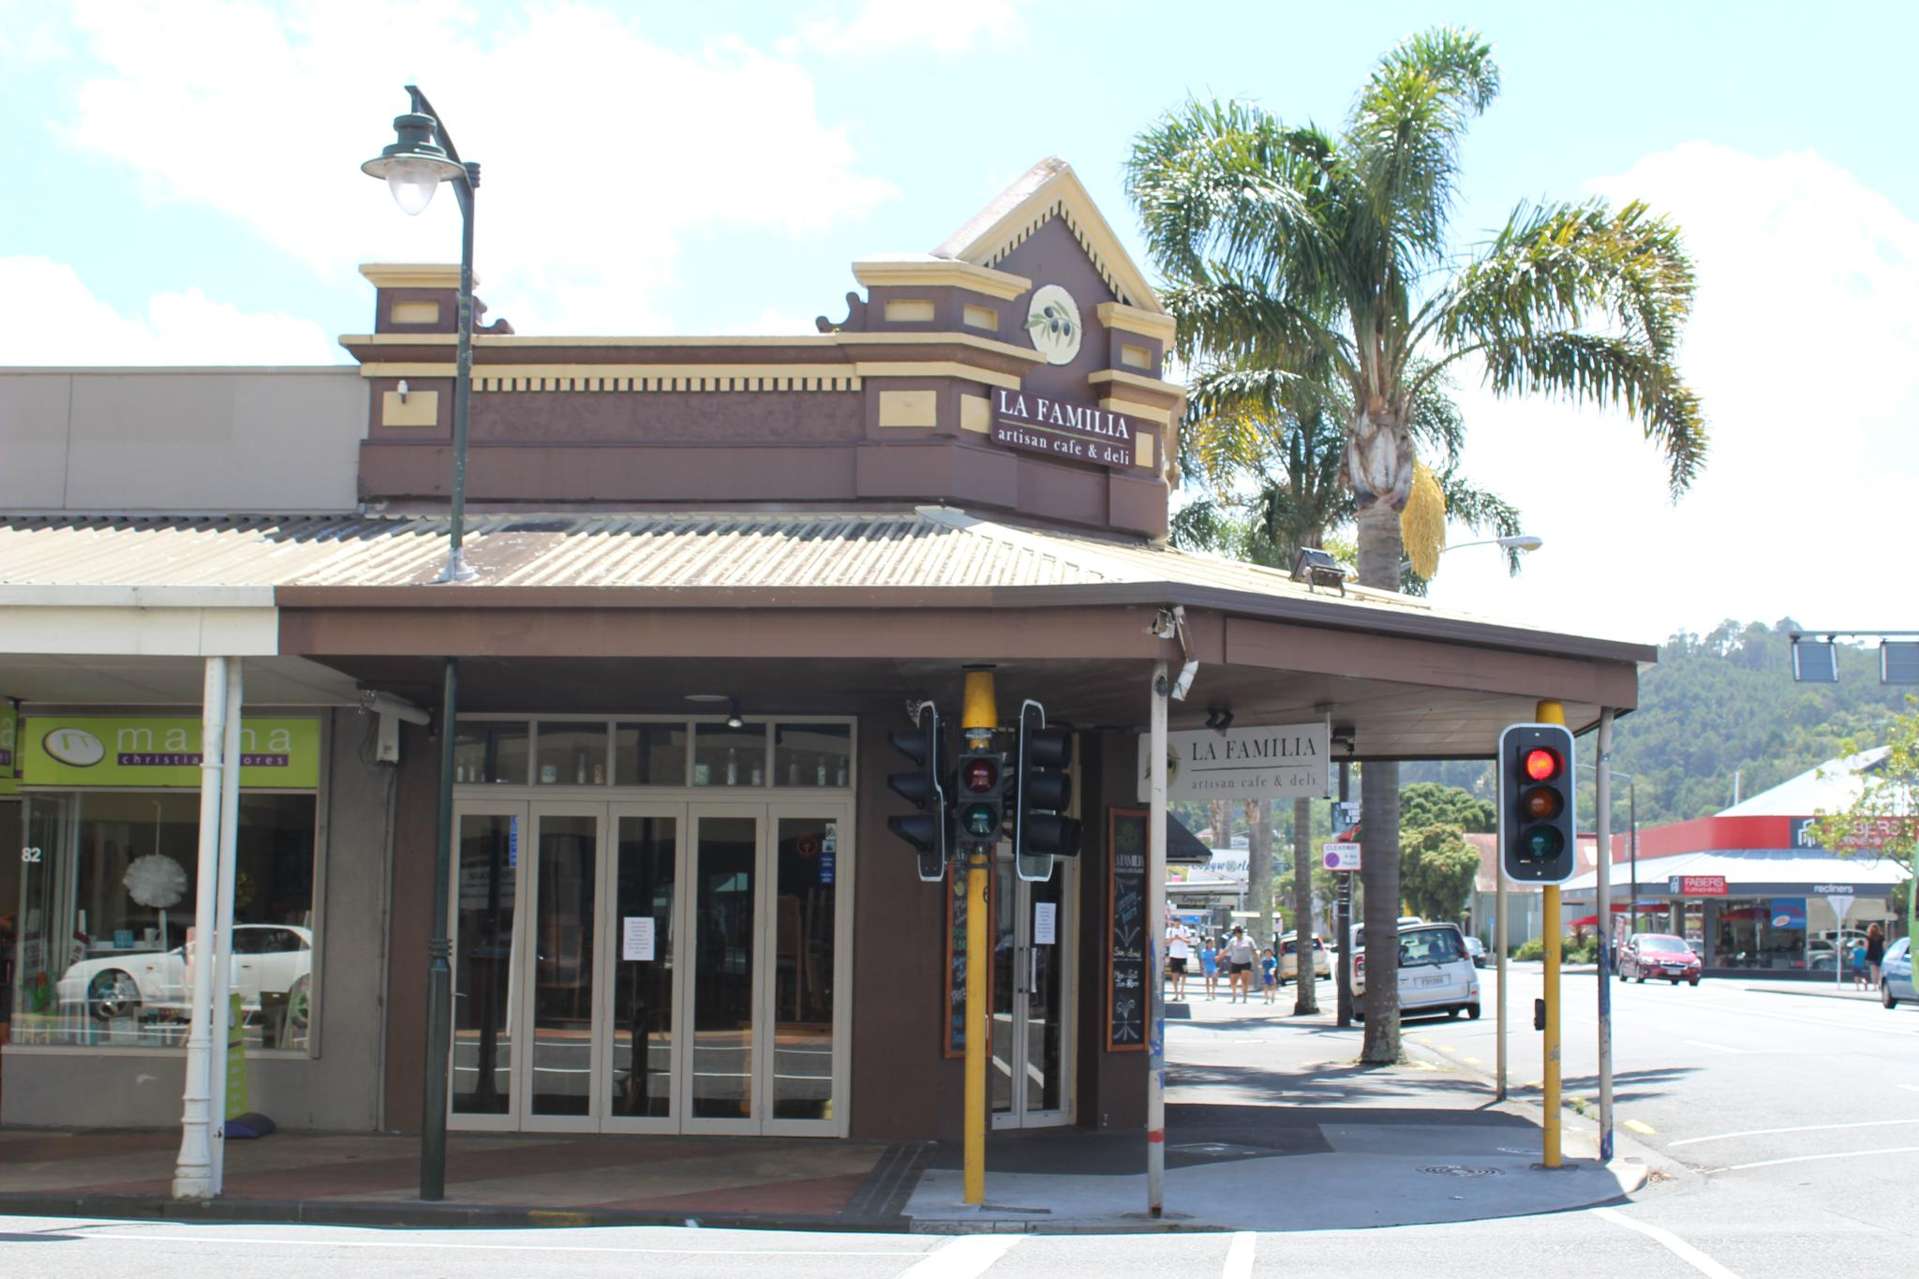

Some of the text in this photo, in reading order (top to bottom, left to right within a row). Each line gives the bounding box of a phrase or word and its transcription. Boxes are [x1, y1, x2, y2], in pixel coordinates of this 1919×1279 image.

[999, 390, 1131, 439] LA FAMILIA
[998, 428, 1130, 465] artisan cafe & deli
[116, 727, 292, 752] mana
[1191, 736, 1317, 761] LA FAMILIA
[121, 755, 206, 765] christia
[1191, 776, 1235, 790] artisan
[1241, 774, 1268, 788] cafe
[1273, 774, 1283, 787] &
[21, 847, 42, 863] 82
[1814, 885, 1854, 894] recliners
